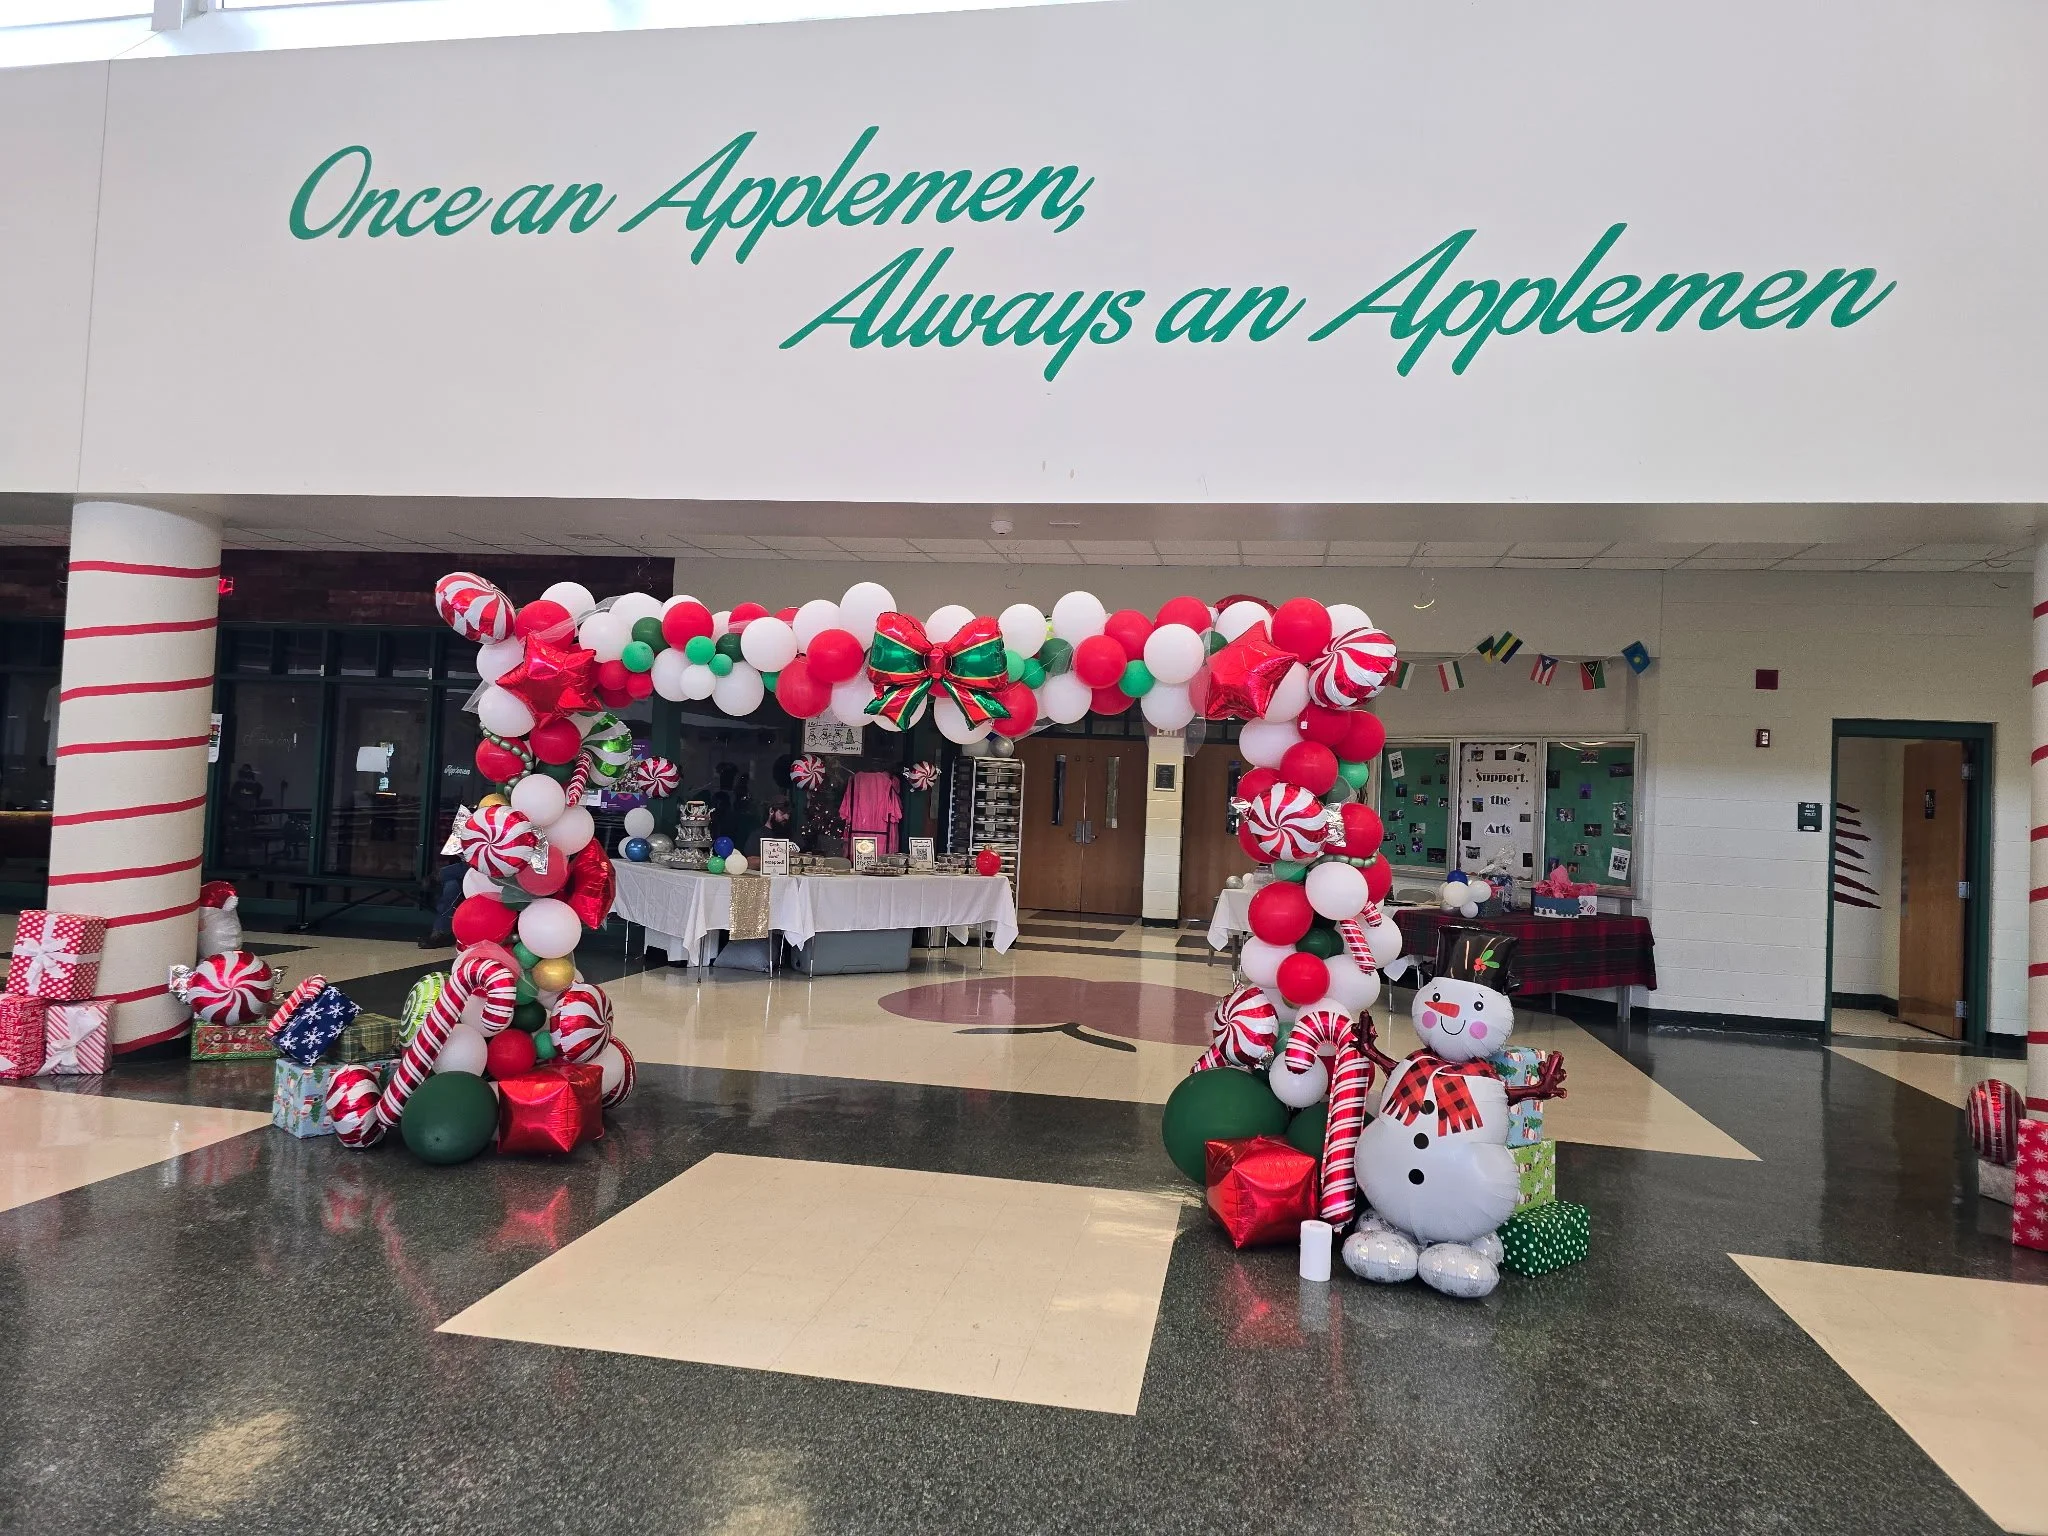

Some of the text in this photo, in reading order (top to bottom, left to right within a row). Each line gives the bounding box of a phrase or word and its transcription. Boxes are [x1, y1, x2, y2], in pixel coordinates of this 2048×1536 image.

[290, 126, 1095, 265] Once an Applemen,
[780, 223, 1896, 382] Always an Applemen
[1485, 823, 1511, 834] Arts
[1490, 795, 1511, 806] the
